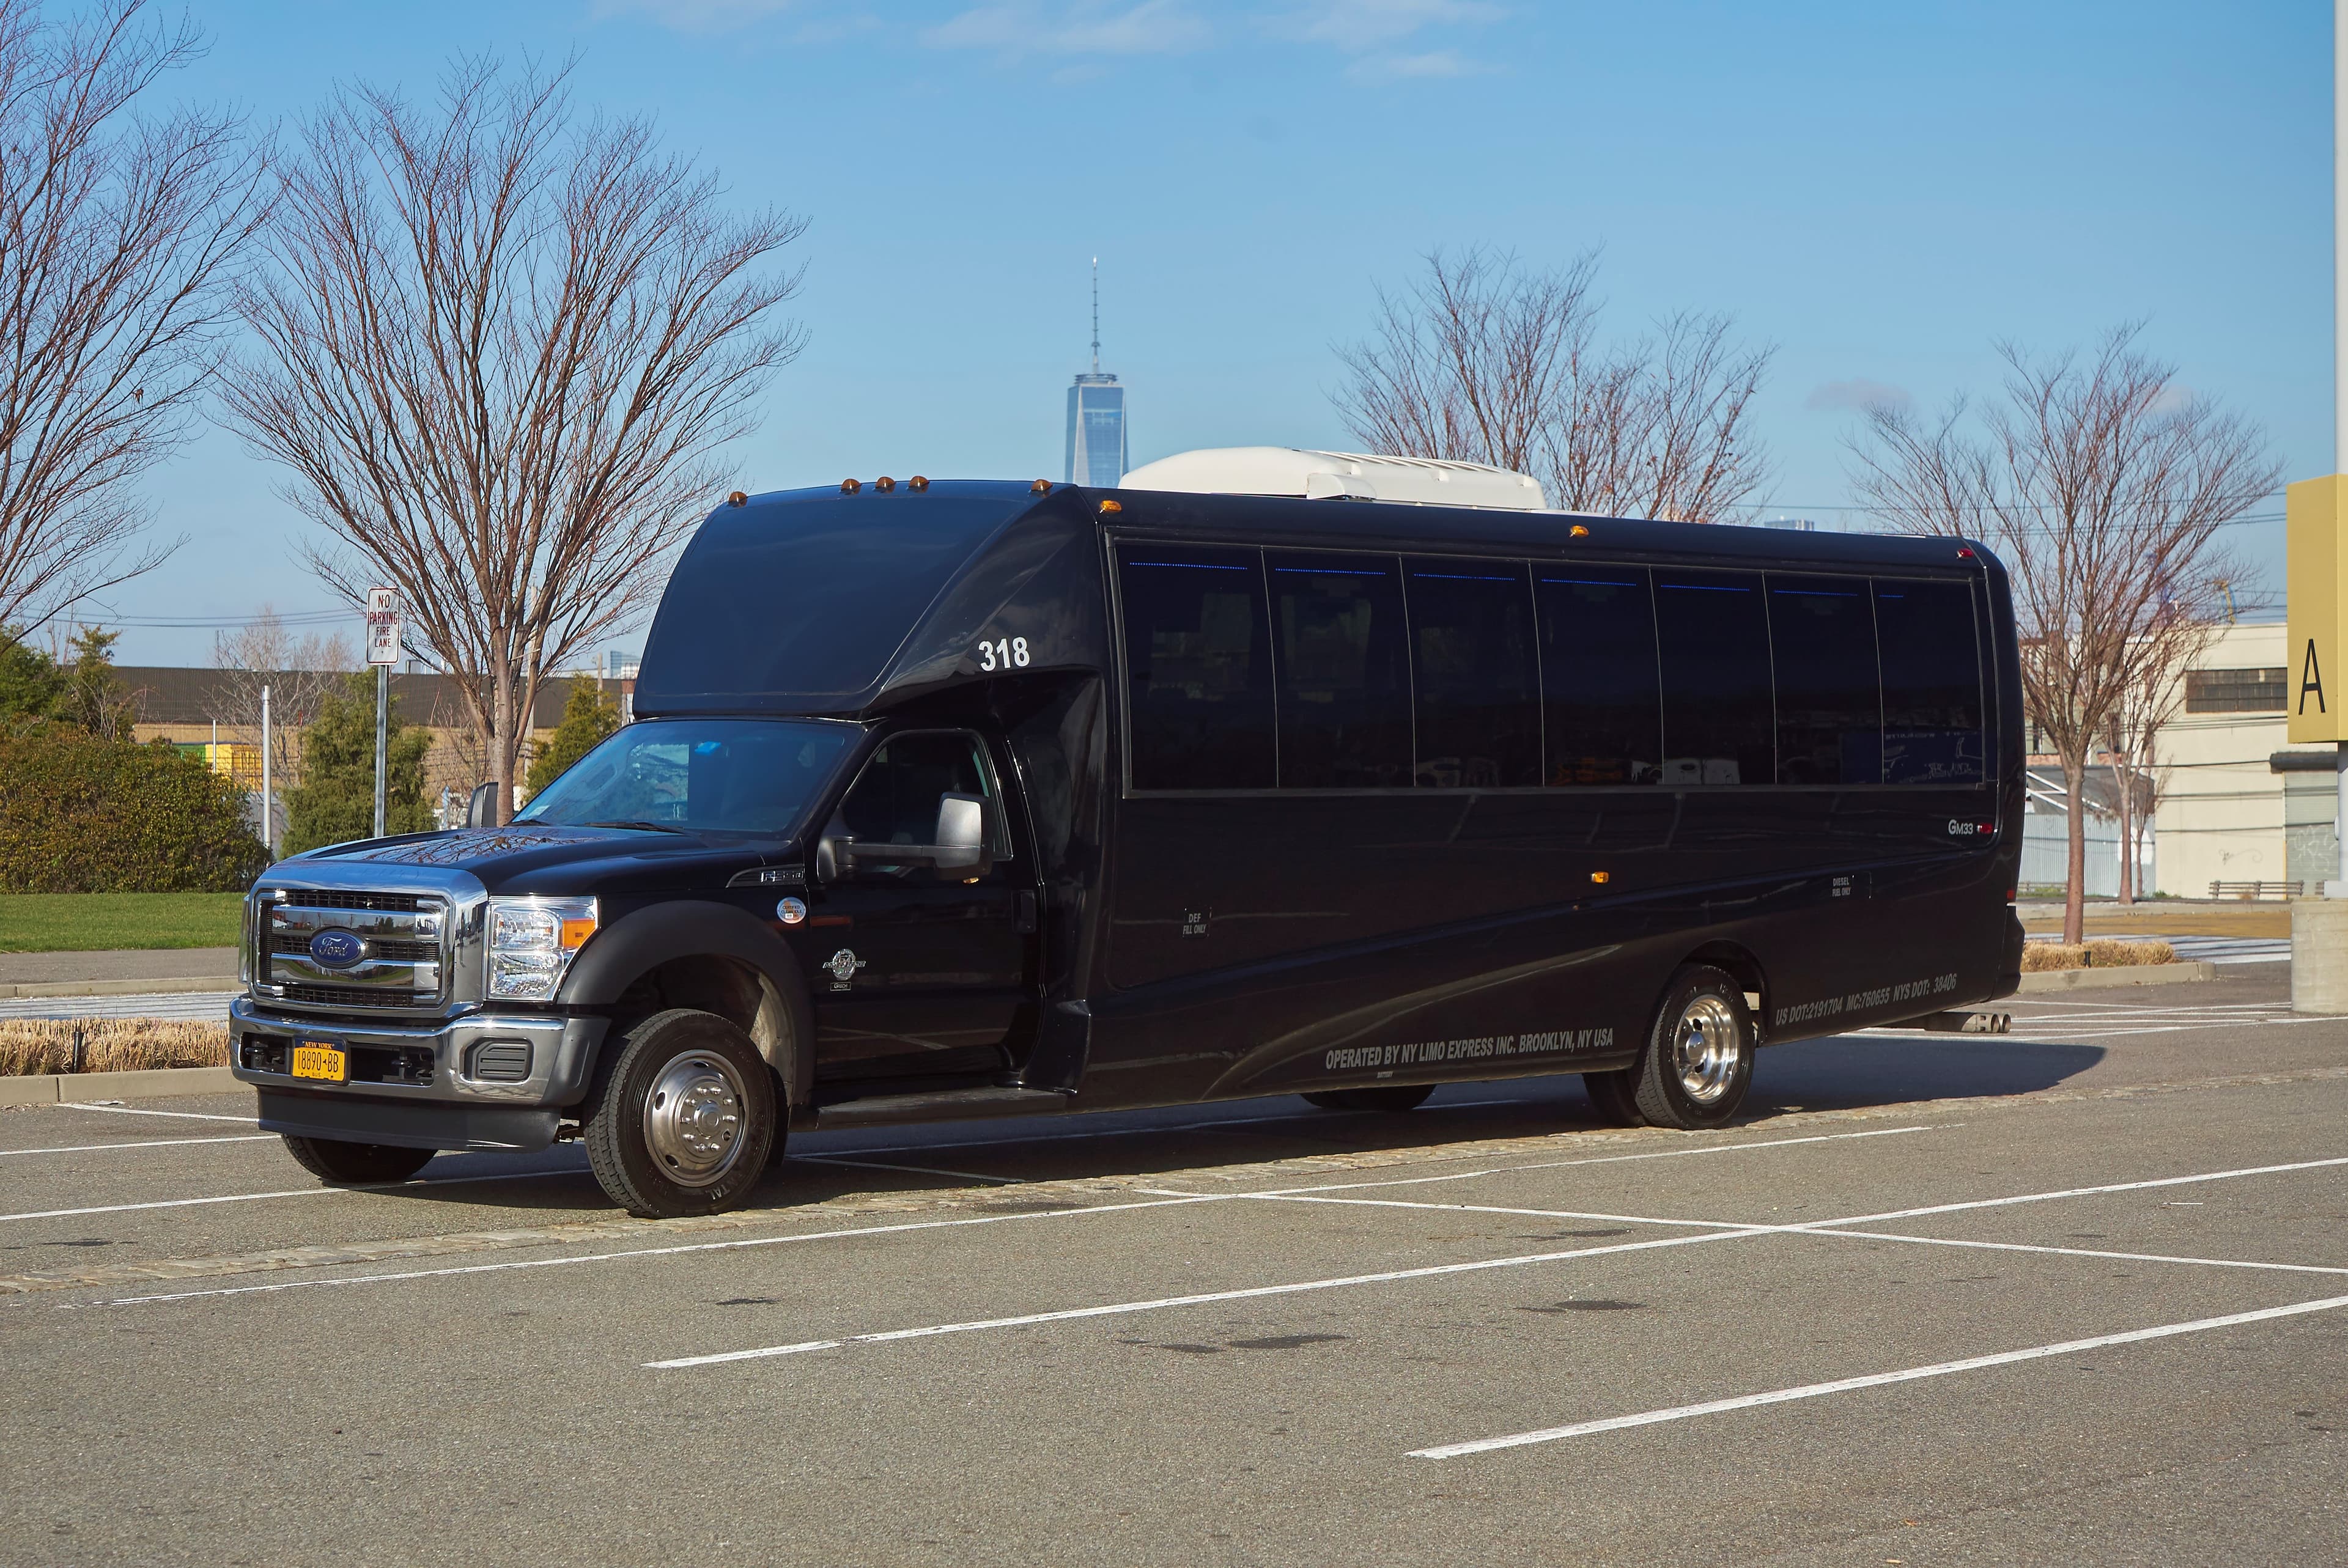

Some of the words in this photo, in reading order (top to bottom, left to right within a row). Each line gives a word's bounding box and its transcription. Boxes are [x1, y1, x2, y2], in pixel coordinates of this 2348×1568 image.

[378, 594, 390, 608] NO
[369, 611, 397, 625] PARKING
[376, 626, 390, 636] FIRE
[375, 638, 391, 647] LANE
[978, 636, 1030, 671] 318
[2298, 638, 2326, 716] A
[1833, 877, 1850, 886] DIESEL
[1832, 888, 1841, 897] FUEL
[1842, 887, 1851, 896] ONLY
[1188, 913, 1202, 924] DEF
[1183, 925, 1193, 935] FILL
[1194, 924, 1207, 934] ONLY
[319, 937, 349, 956] Ford
[1776, 1007, 1788, 1026] US
[1893, 983, 1911, 1002] NYS
[1911, 979, 1930, 998] DOT:
[1933, 973, 1957, 993] 38406
[1326, 1046, 1383, 1070] OPERATED
[1384, 1045, 1400, 1064] BY
[1401, 1043, 1418, 1063] NY
[1419, 1041, 1445, 1062] LIMO
[1447, 1037, 1494, 1059] EXPRESS
[1496, 1036, 1516, 1055] INC.
[1519, 1031, 1575, 1053] BROOKLYN,
[1577, 1029, 1593, 1048] NY
[1593, 1028, 1614, 1047] USA
